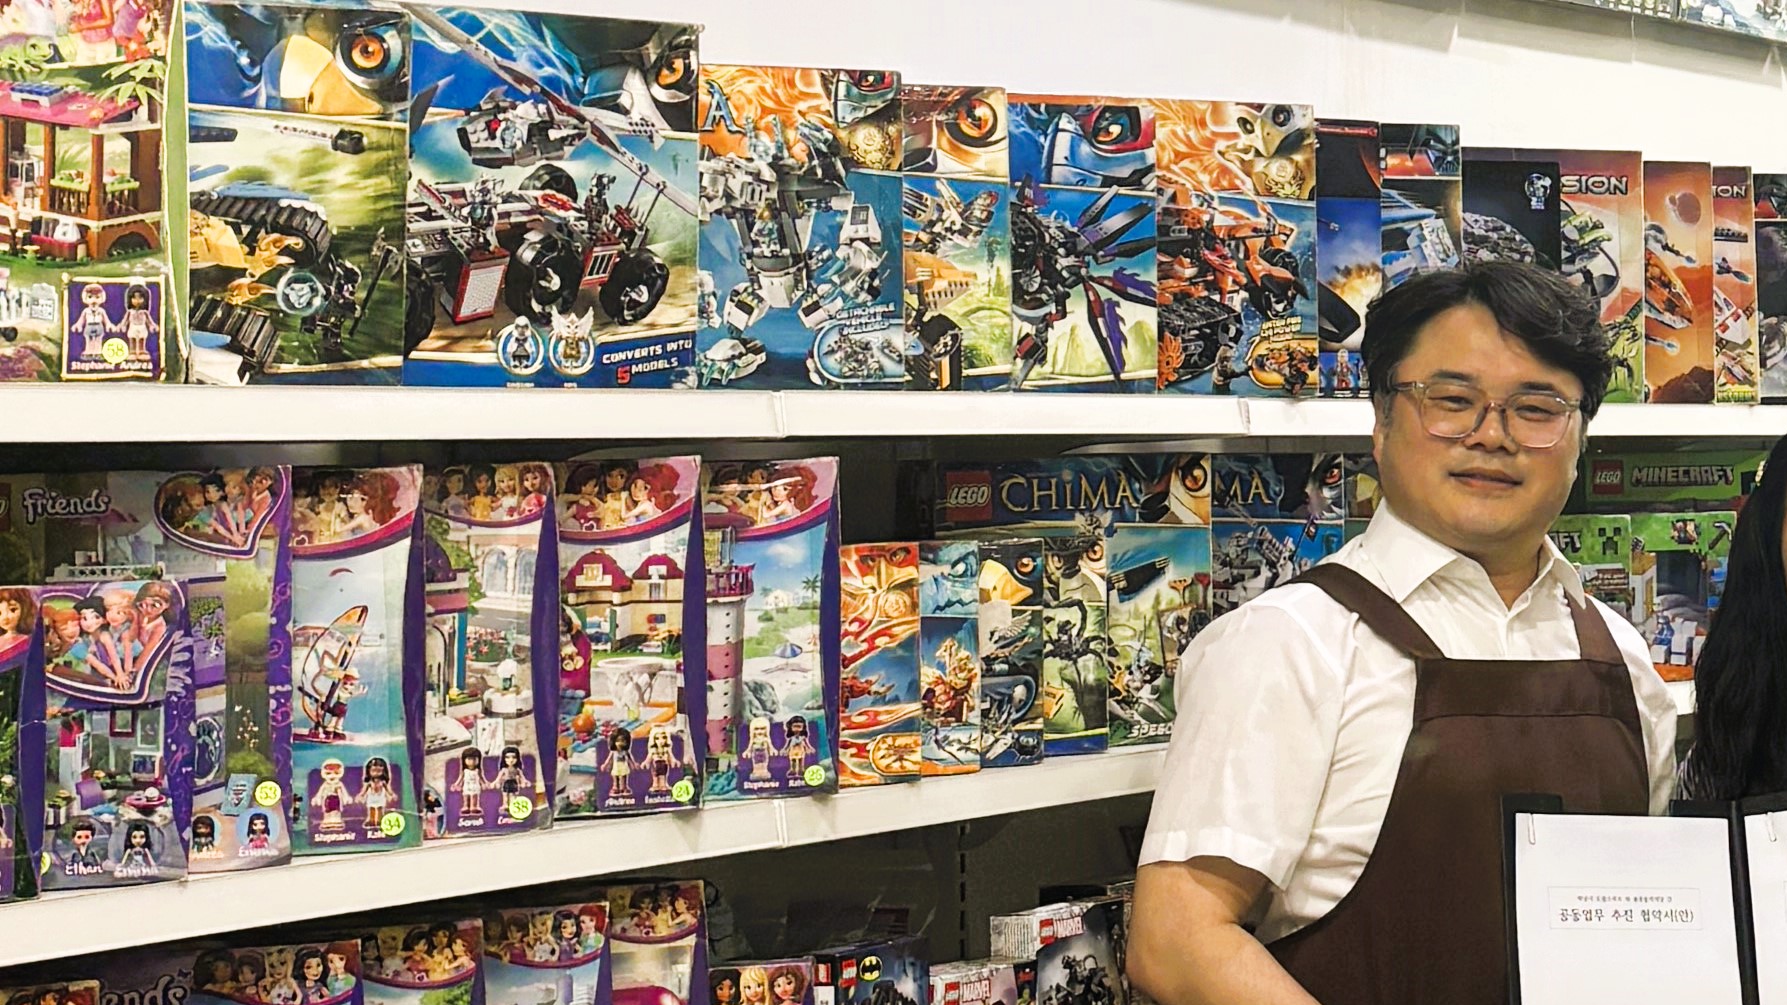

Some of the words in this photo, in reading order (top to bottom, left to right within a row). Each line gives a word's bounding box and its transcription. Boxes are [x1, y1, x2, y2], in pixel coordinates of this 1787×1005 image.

[107, 342, 125, 358] 58
[602, 348, 662, 364] CONVERTS
[667, 339, 692, 353] INTO
[616, 365, 630, 384] 5
[631, 357, 679, 374] MODELS
[1596, 472, 1620, 484] LEGO
[1631, 465, 1735, 486] MINECRAFT
[950, 485, 989, 505] LEGO
[1001, 469, 1141, 512] CHIMA
[65, 864, 103, 876] Ethan
